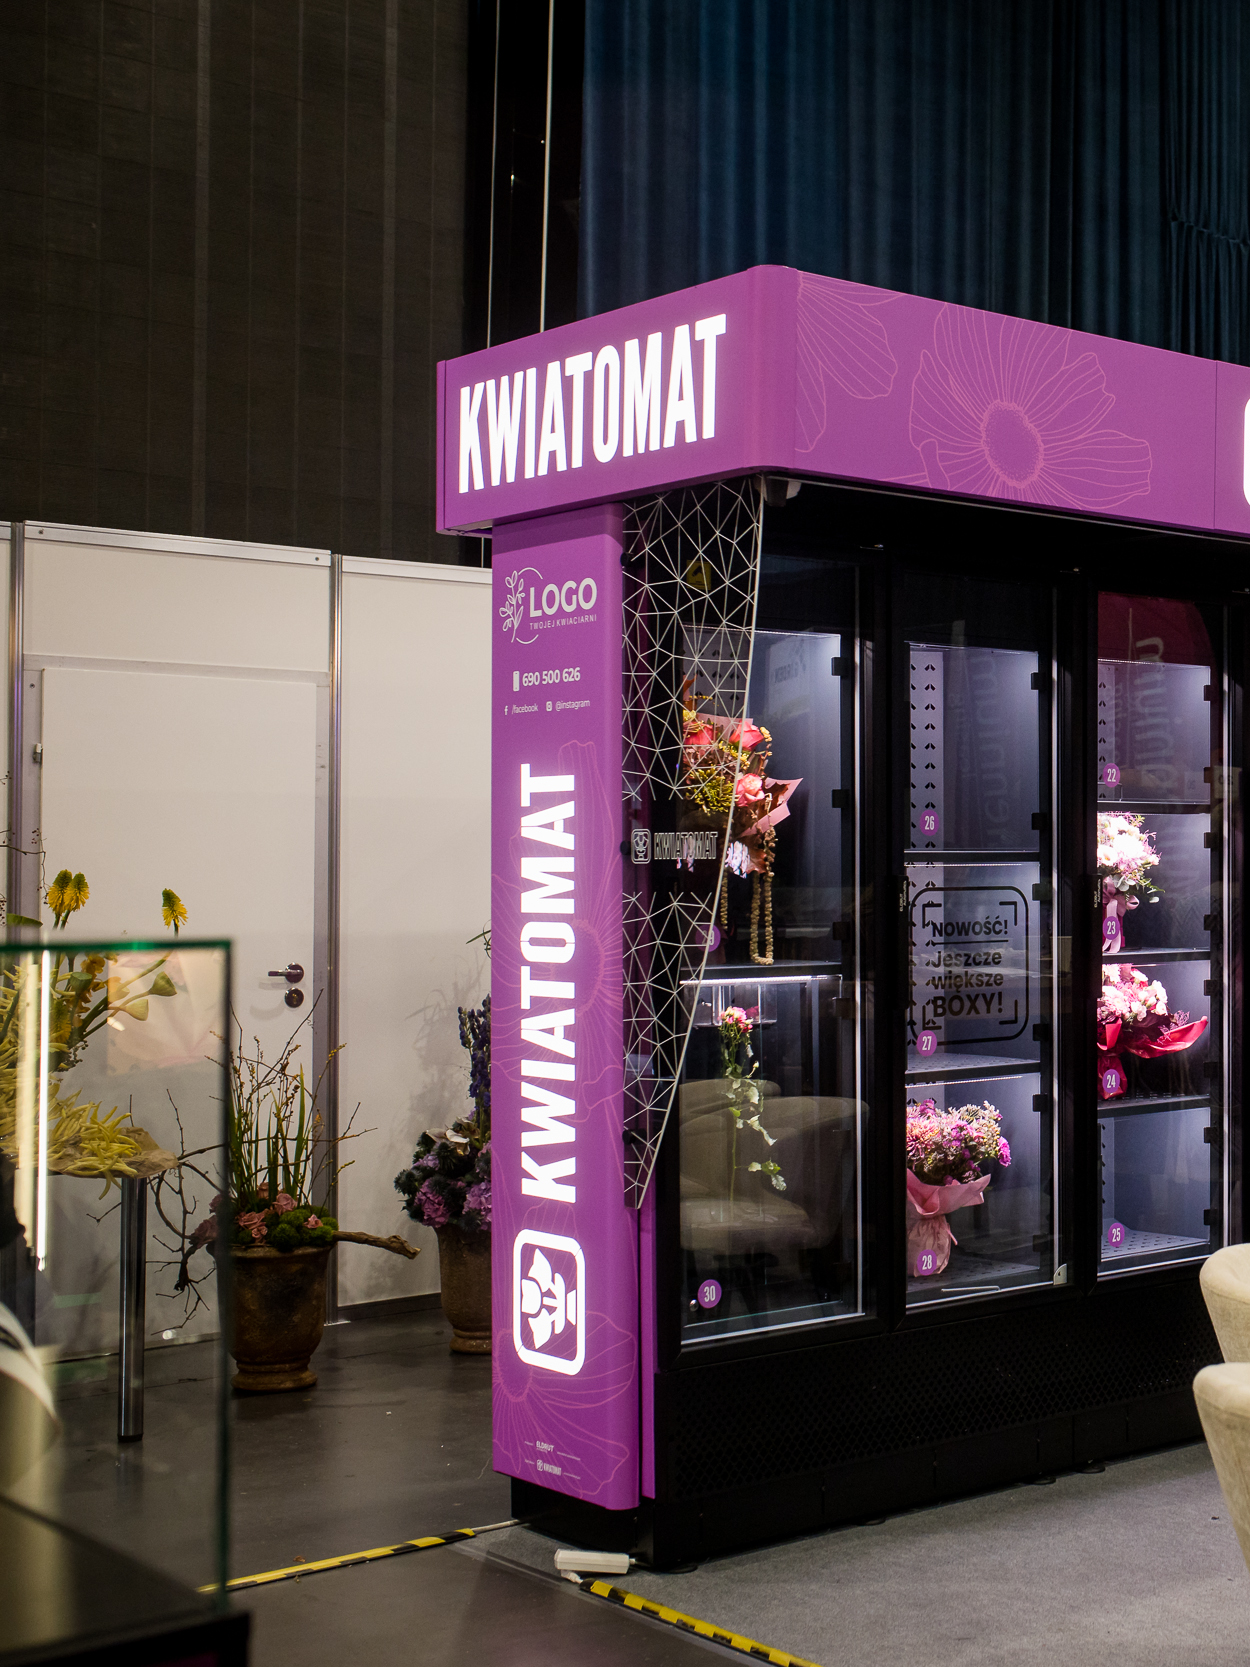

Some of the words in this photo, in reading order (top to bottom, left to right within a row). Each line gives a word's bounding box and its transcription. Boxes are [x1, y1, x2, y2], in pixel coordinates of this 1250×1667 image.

[459, 314, 726, 494] KWIATOMAT
[529, 577, 598, 618] LOGO
[529, 620, 555, 631] TWOJEJ
[556, 614, 597, 627] KWIACIARNI
[522, 672, 540, 687] 690
[541, 669, 561, 685] 500
[562, 667, 581, 683] 626
[511, 703, 539, 715] /facebook
[555, 700, 591, 712] @instagram
[1107, 769, 1116, 782] 22
[924, 816, 935, 831] 26
[654, 831, 719, 860] KWIATOMAT
[932, 915, 1008, 937] NOWOŚĆ!
[1107, 921, 1116, 935] 23
[932, 951, 1002, 968] Jeszcze
[520, 763, 576, 1204] KWIATOMAT
[932, 970, 1004, 993] większe
[932, 991, 1003, 1018] BOXY!
[922, 1036, 932, 1051] 27
[1107, 1074, 1116, 1088] 24
[1112, 1228, 1121, 1242] 25
[922, 1255, 932, 1270] 28
[704, 1285, 716, 1301] 30
